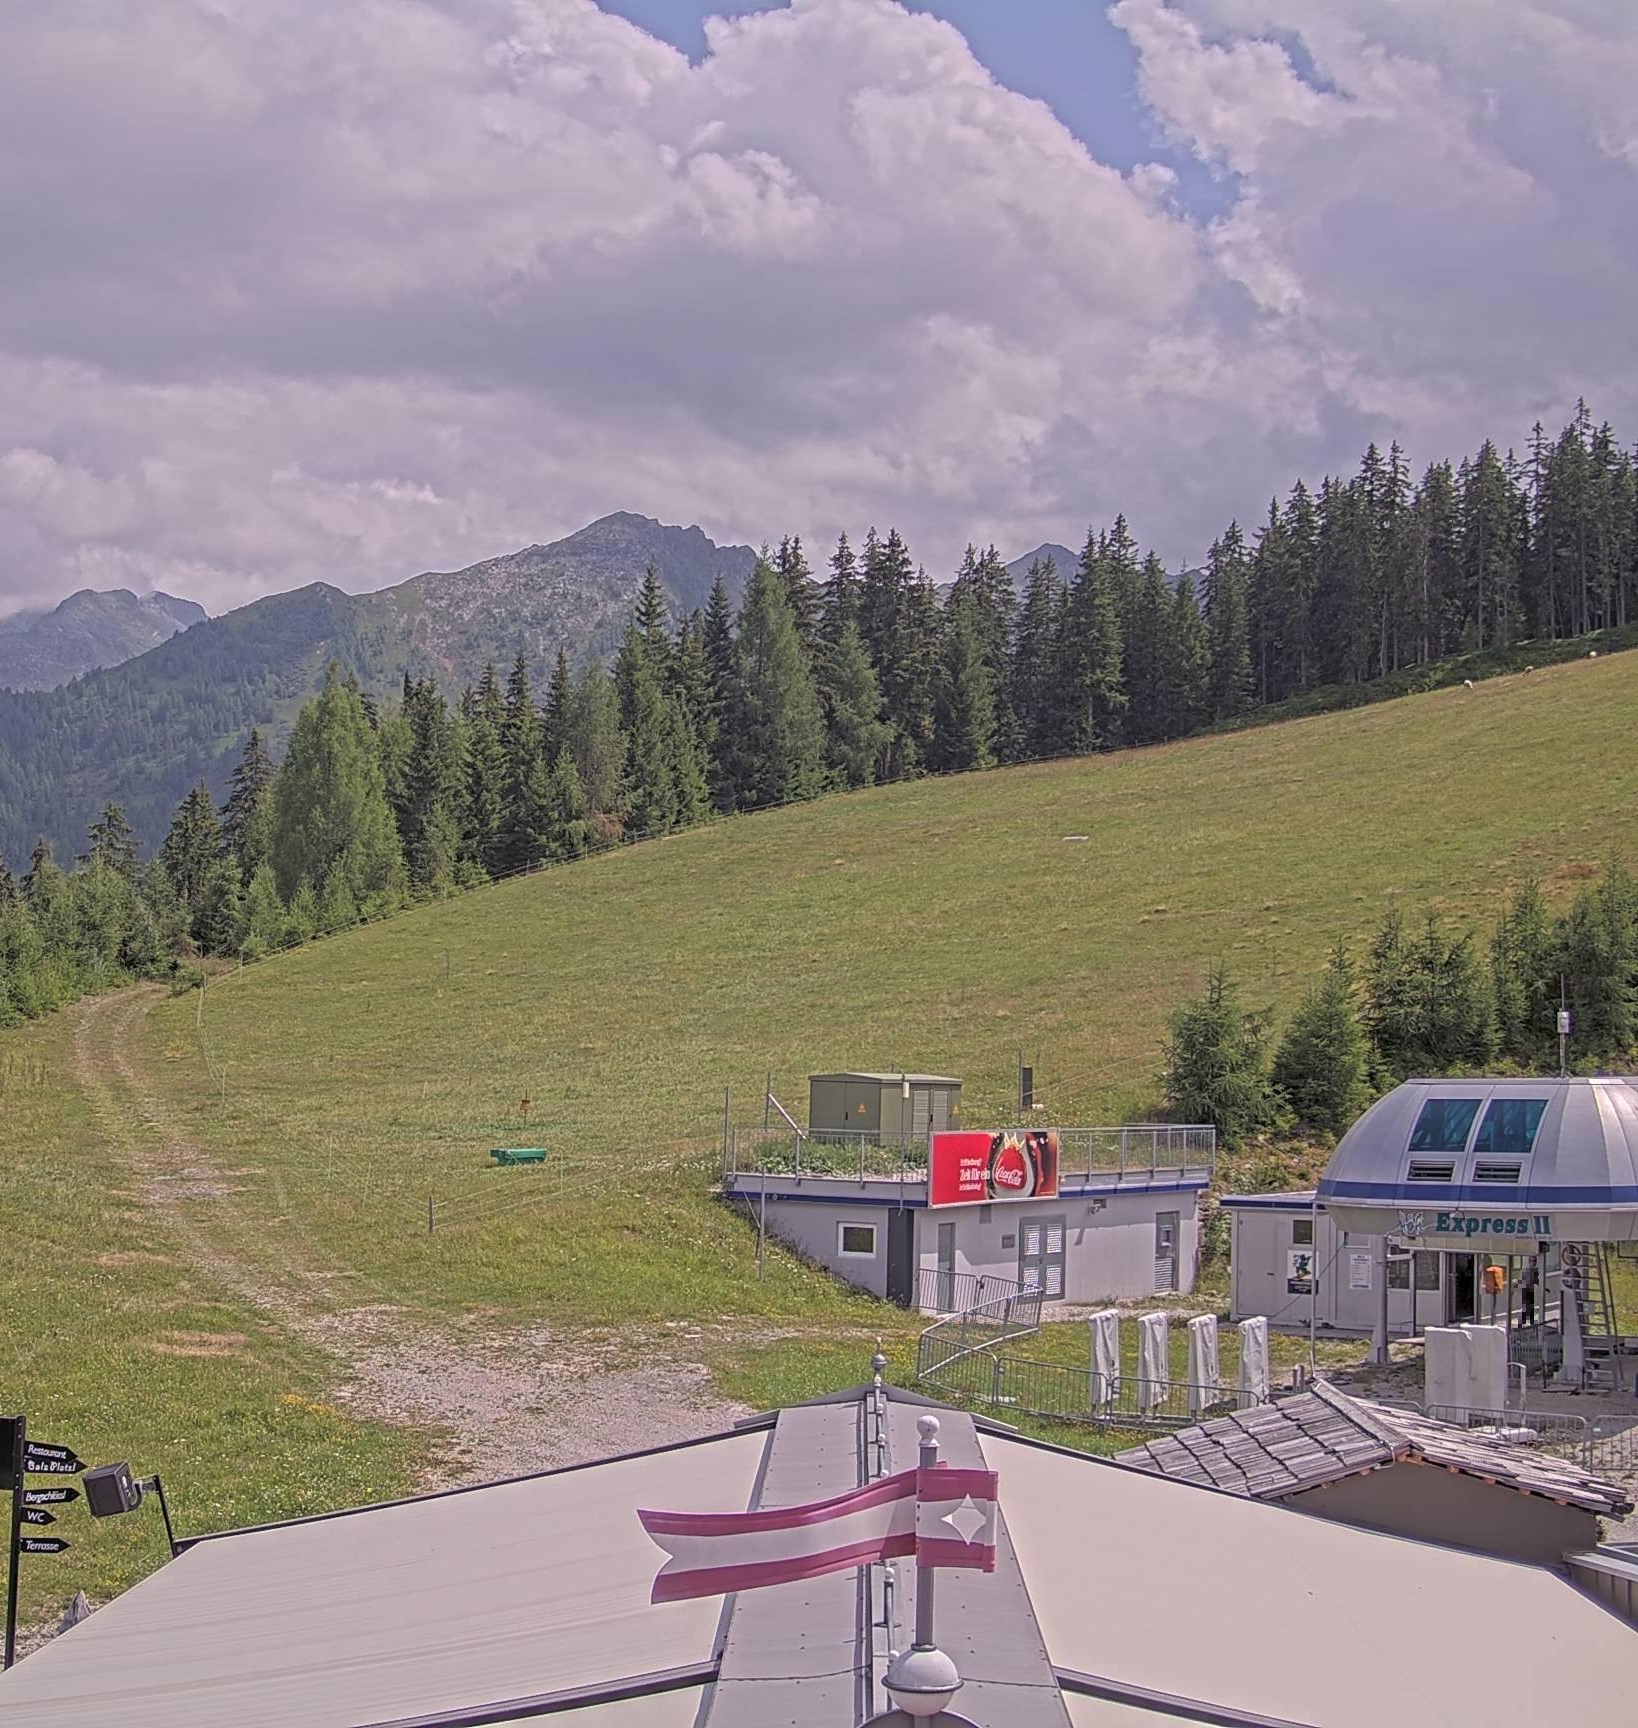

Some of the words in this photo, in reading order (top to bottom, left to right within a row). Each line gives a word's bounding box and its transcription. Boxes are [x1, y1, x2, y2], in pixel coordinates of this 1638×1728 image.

[1436, 1212, 1529, 1237] Express
[1533, 1215, 1551, 1234] II
[27, 1510, 45, 1522] WC
[26, 1540, 60, 1550] Terrasse
